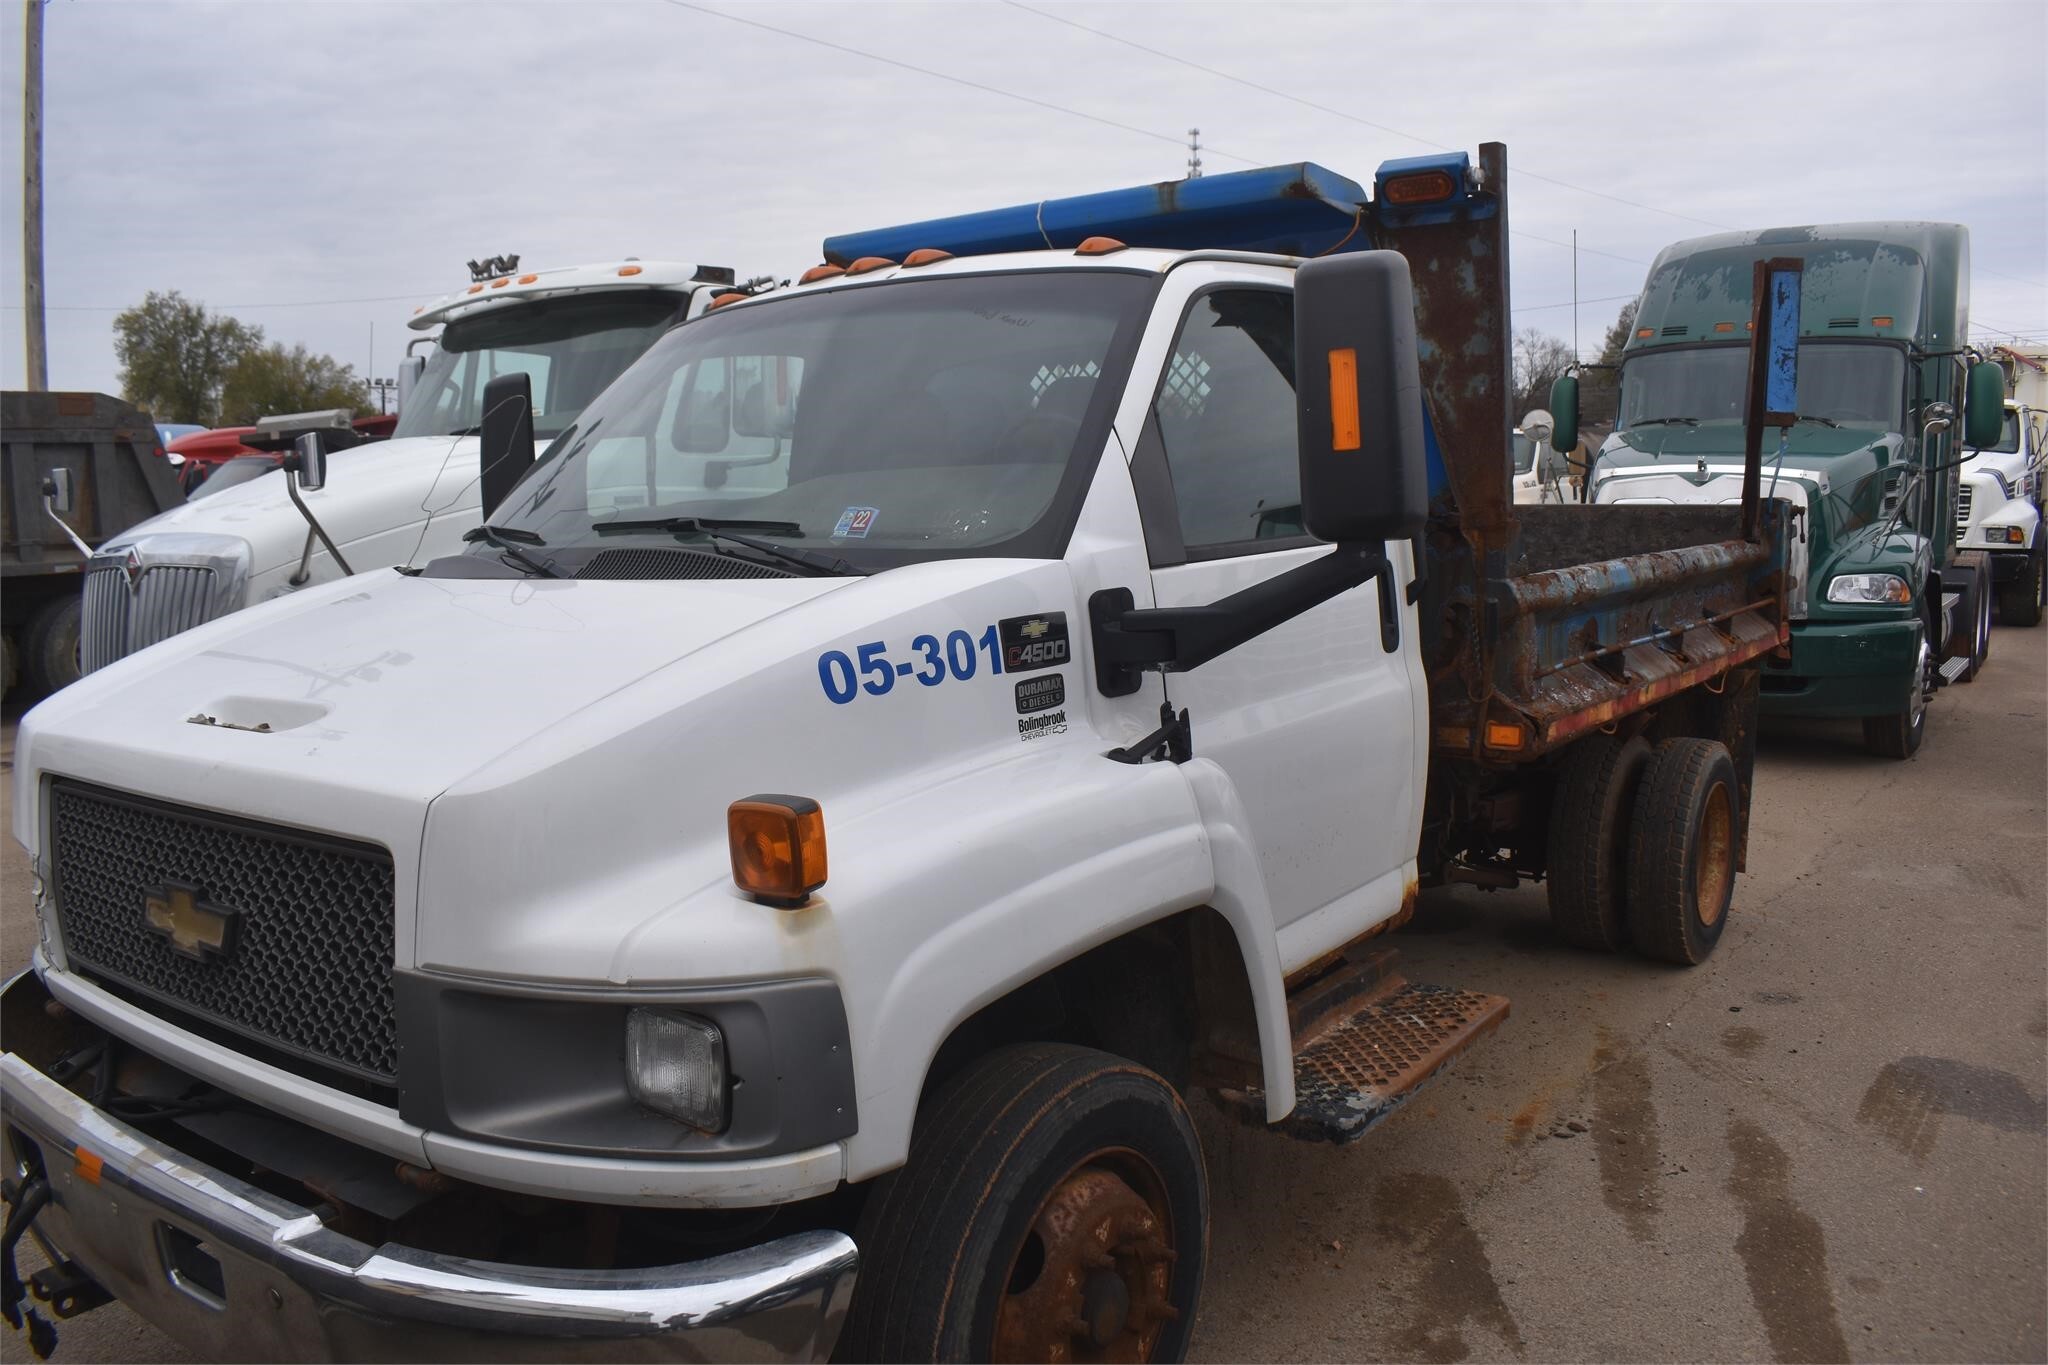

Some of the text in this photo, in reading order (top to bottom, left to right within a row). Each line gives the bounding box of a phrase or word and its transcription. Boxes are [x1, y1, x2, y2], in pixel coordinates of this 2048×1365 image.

[852, 510, 871, 528] 22
[1008, 639, 1066, 666] C4500
[817, 625, 1002, 705] 05-301
[1018, 676, 1063, 698] DURAMAX
[1029, 693, 1055, 708] DIESEL
[1018, 709, 1067, 733] Bolingbrook
[1021, 728, 1052, 742] CHEVROLET
